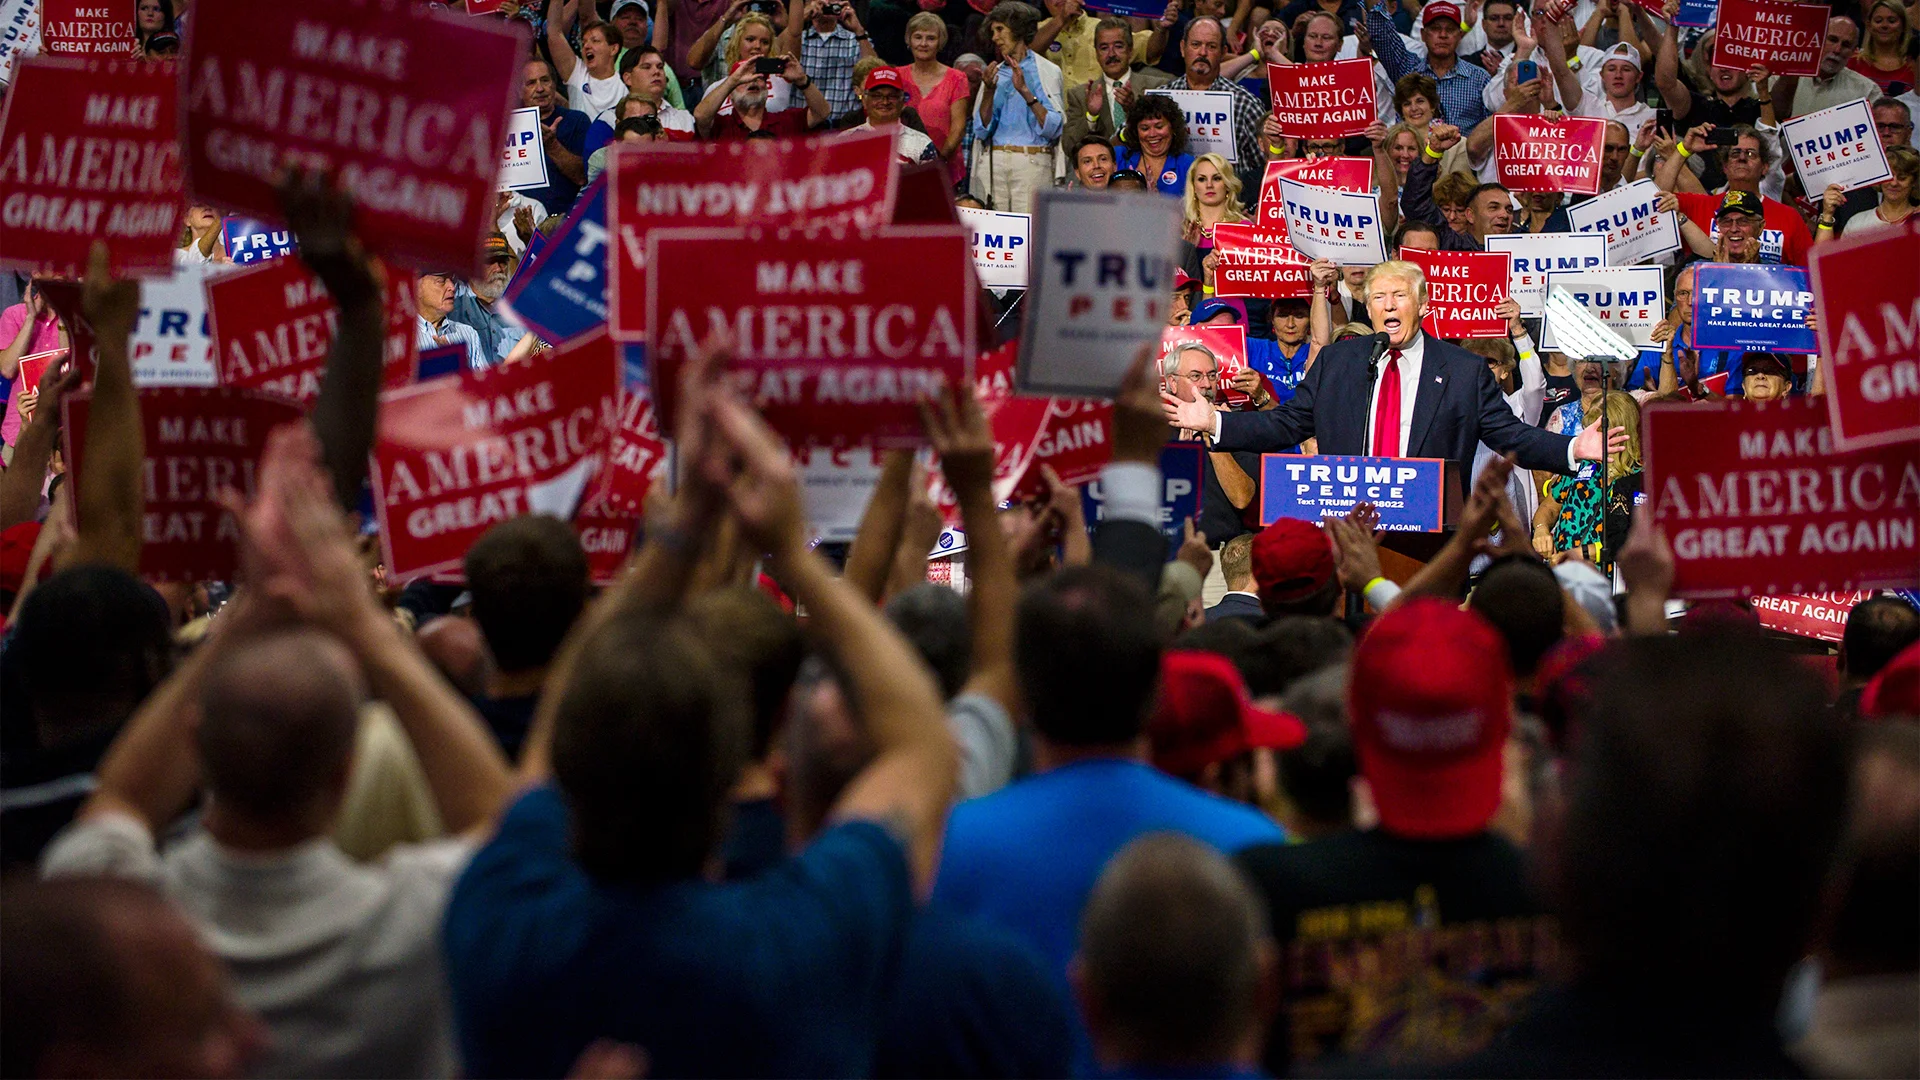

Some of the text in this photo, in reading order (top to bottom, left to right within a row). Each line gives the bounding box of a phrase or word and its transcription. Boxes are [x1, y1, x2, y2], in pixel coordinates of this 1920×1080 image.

[75, 7, 109, 18] MAKE
[1755, 11, 1793, 25] MAKE
[44, 21, 136, 39] AMERICA
[1718, 22, 1822, 49] AMERICA
[51, 41, 131, 53] GREAT AGAIN
[292, 20, 407, 80] MAKE
[1724, 43, 1813, 63] GREAT AGAIN
[1298, 74, 1337, 88] MAKE
[1273, 86, 1373, 109] AMERICA
[84, 93, 160, 129] MAKE
[189, 55, 493, 181] AMERICA
[1279, 108, 1367, 125] GREAT AGAIN
[1529, 127, 1566, 139] MAKE
[1794, 123, 1868, 158] TRUMP
[0, 131, 183, 195] AMERIC
[1498, 142, 1599, 164] AMERICA
[1804, 142, 1866, 169] PENCE
[1298, 169, 1334, 180] MAKE
[1504, 164, 1590, 178] GREAT AGAIN
[1816, 165, 1836, 175] AMERICA
[1835, 160, 1853, 169] GREAT
[339, 160, 468, 229] AGAIN
[636, 166, 875, 218] GREAT AGAIN
[2, 191, 104, 235] GREAT
[1286, 200, 1373, 229] TRUMP
[1252, 233, 1292, 244] MAKE
[1294, 219, 1365, 240] PENCE
[1607, 215, 1659, 243] ENCE
[1628, 234, 1645, 243] GREAT
[1306, 235, 1327, 245] AMERICA
[243, 247, 291, 263] PEN
[1219, 247, 1308, 266] AMERIC
[1513, 256, 1600, 273] RUMP
[755, 258, 865, 296] MAKE
[1225, 269, 1270, 282] GREAT
[1430, 264, 1470, 278] MAKE
[283, 275, 331, 310] MA
[1425, 281, 1504, 303] ERICA
[1573, 291, 1657, 307] RUMP
[1702, 287, 1815, 307] TRUMP
[1450, 307, 1498, 321] AGAIN
[1600, 309, 1649, 320] NCE
[1711, 306, 1803, 320] PENCE
[659, 303, 964, 361] AMERICA
[815, 366, 947, 405] AGAIN
[461, 380, 555, 430] MAKE
[158, 415, 249, 447] MAKE
[1036, 419, 1105, 458] GAIN
[1286, 464, 1418, 485] TRUMP
[1297, 484, 1404, 499] PENCE
[1655, 462, 1920, 520] AMERICA
[406, 486, 524, 539] GREAT
[1297, 498, 1315, 506] Text
[1318, 498, 1356, 507] TRUMP
[1320, 508, 1351, 517] Akron
[142, 511, 208, 545] EAT
[1388, 523, 1421, 531] AGAIN!
[579, 527, 627, 553] GAIN
[1673, 516, 1916, 561] GREAT AGAIN
[1750, 594, 1800, 615] GREAT
